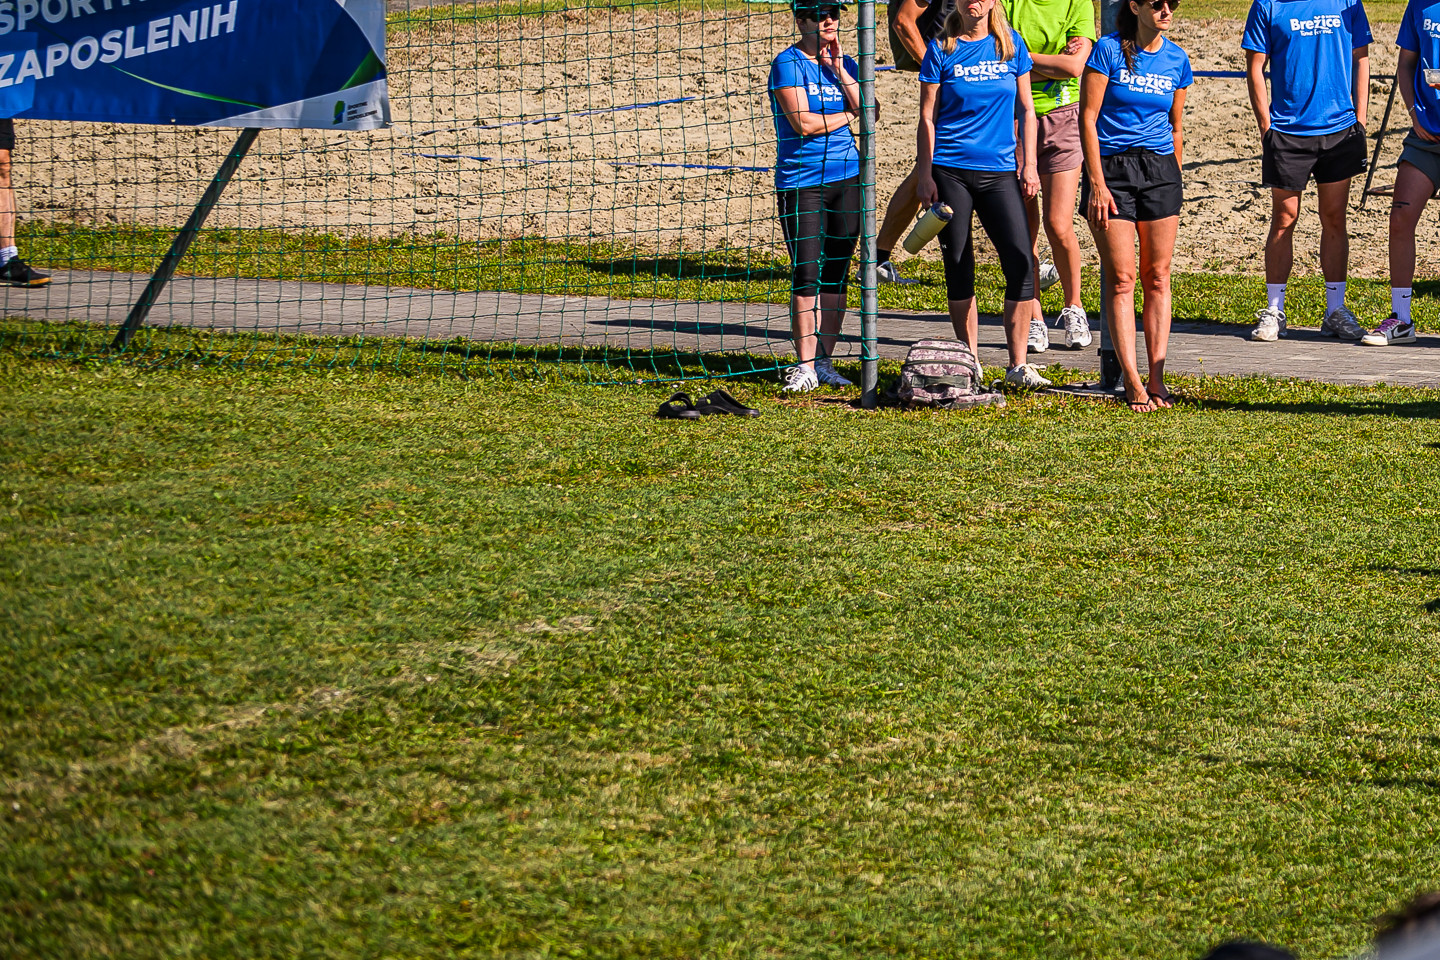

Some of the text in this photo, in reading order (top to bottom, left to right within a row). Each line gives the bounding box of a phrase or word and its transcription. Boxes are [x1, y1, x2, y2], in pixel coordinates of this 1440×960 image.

[1289, 15, 1341, 31] Brežice
[0, 0, 239, 89] ZAPOSLENIH
[953, 60, 1009, 77] Brežice
[1120, 69, 1173, 91] Brežice
